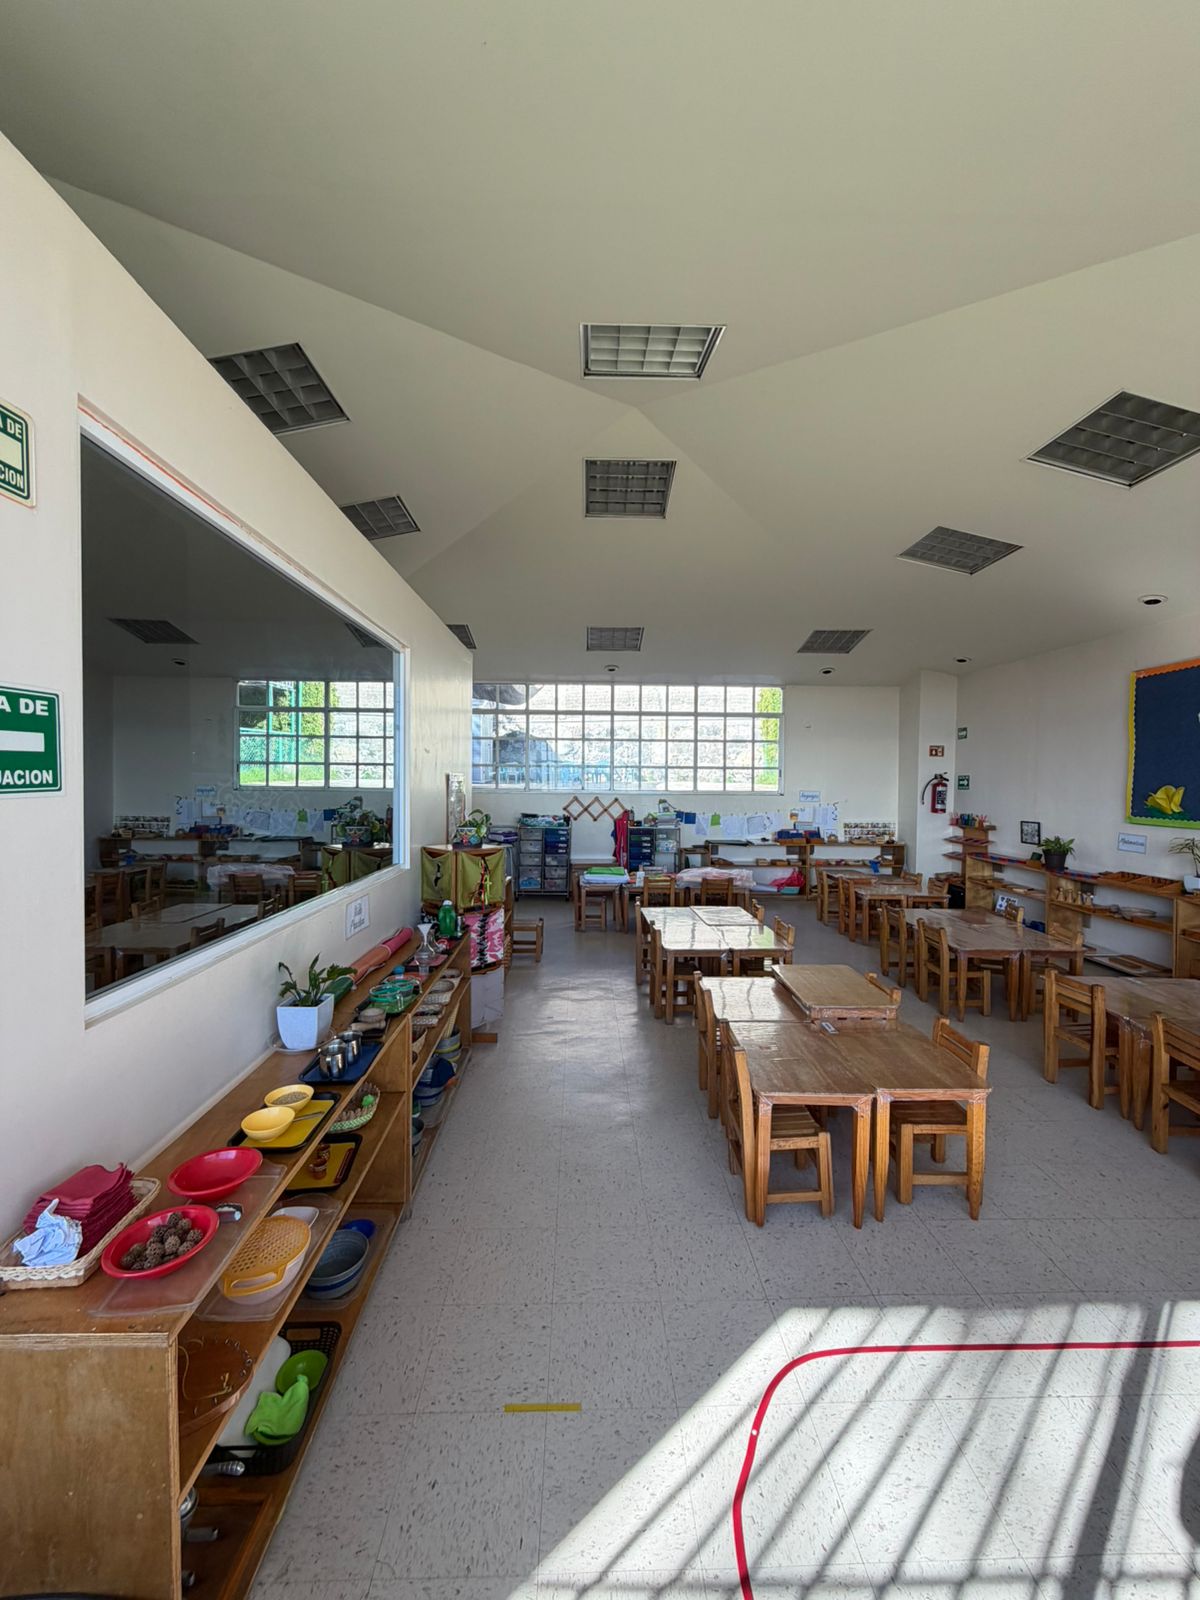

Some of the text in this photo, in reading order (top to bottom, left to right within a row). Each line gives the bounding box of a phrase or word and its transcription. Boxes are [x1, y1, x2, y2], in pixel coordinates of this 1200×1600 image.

[7, 417, 22, 439] DE
[19, 697, 49, 716] DE
[0, 769, 53, 785] ACION
